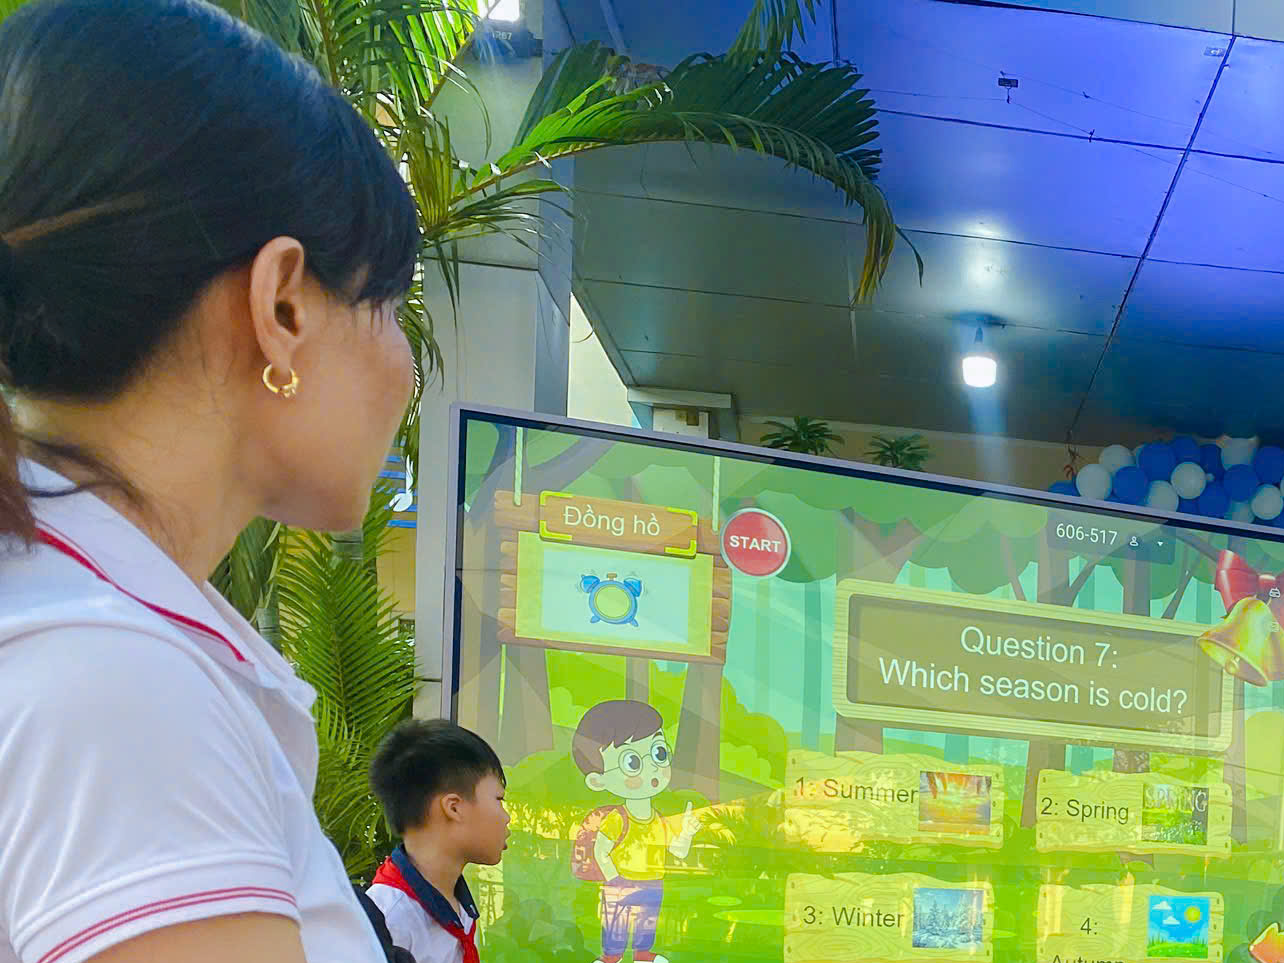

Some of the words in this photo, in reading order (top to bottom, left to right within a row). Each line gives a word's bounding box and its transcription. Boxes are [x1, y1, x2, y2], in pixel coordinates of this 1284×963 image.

[563, 504, 625, 536] Đồng
[633, 513, 660, 536] hồ
[729, 535, 781, 553] START
[1055, 523, 1118, 546] 606-517
[960, 625, 1085, 665] Question
[1095, 642, 1119, 668] 7:
[879, 657, 970, 693] Which
[979, 674, 1080, 704] season
[1089, 680, 1110, 707] is
[1119, 687, 1188, 714] cold?
[795, 776, 814, 797] 1:
[823, 777, 919, 804] Summer
[1040, 797, 1059, 816] 2:
[1066, 799, 1129, 825] Spring
[803, 905, 823, 925] 3:
[832, 906, 905, 928] Winter
[1080, 917, 1098, 936] 4:
